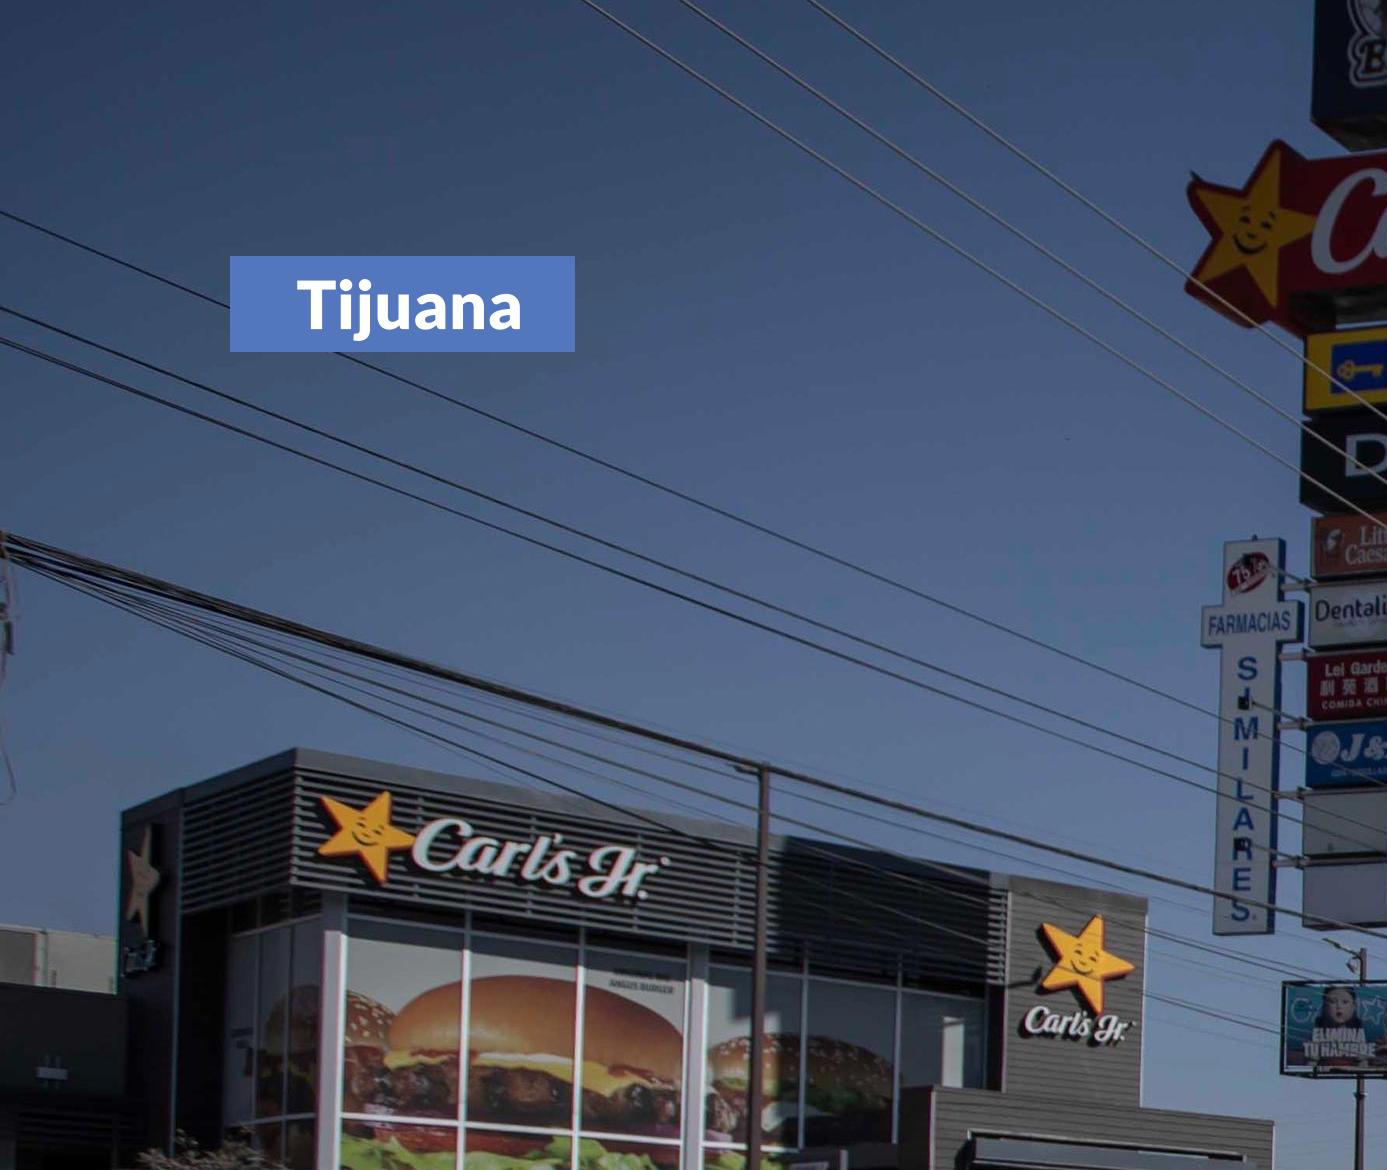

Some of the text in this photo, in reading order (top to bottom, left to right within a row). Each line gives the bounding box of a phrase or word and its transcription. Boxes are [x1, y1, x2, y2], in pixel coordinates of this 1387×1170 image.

[1208, 611, 1291, 637] FARMACIAS
[411, 818, 660, 900] Carl's Jr.
[1024, 1005, 1129, 1042] Carl's Jr.
